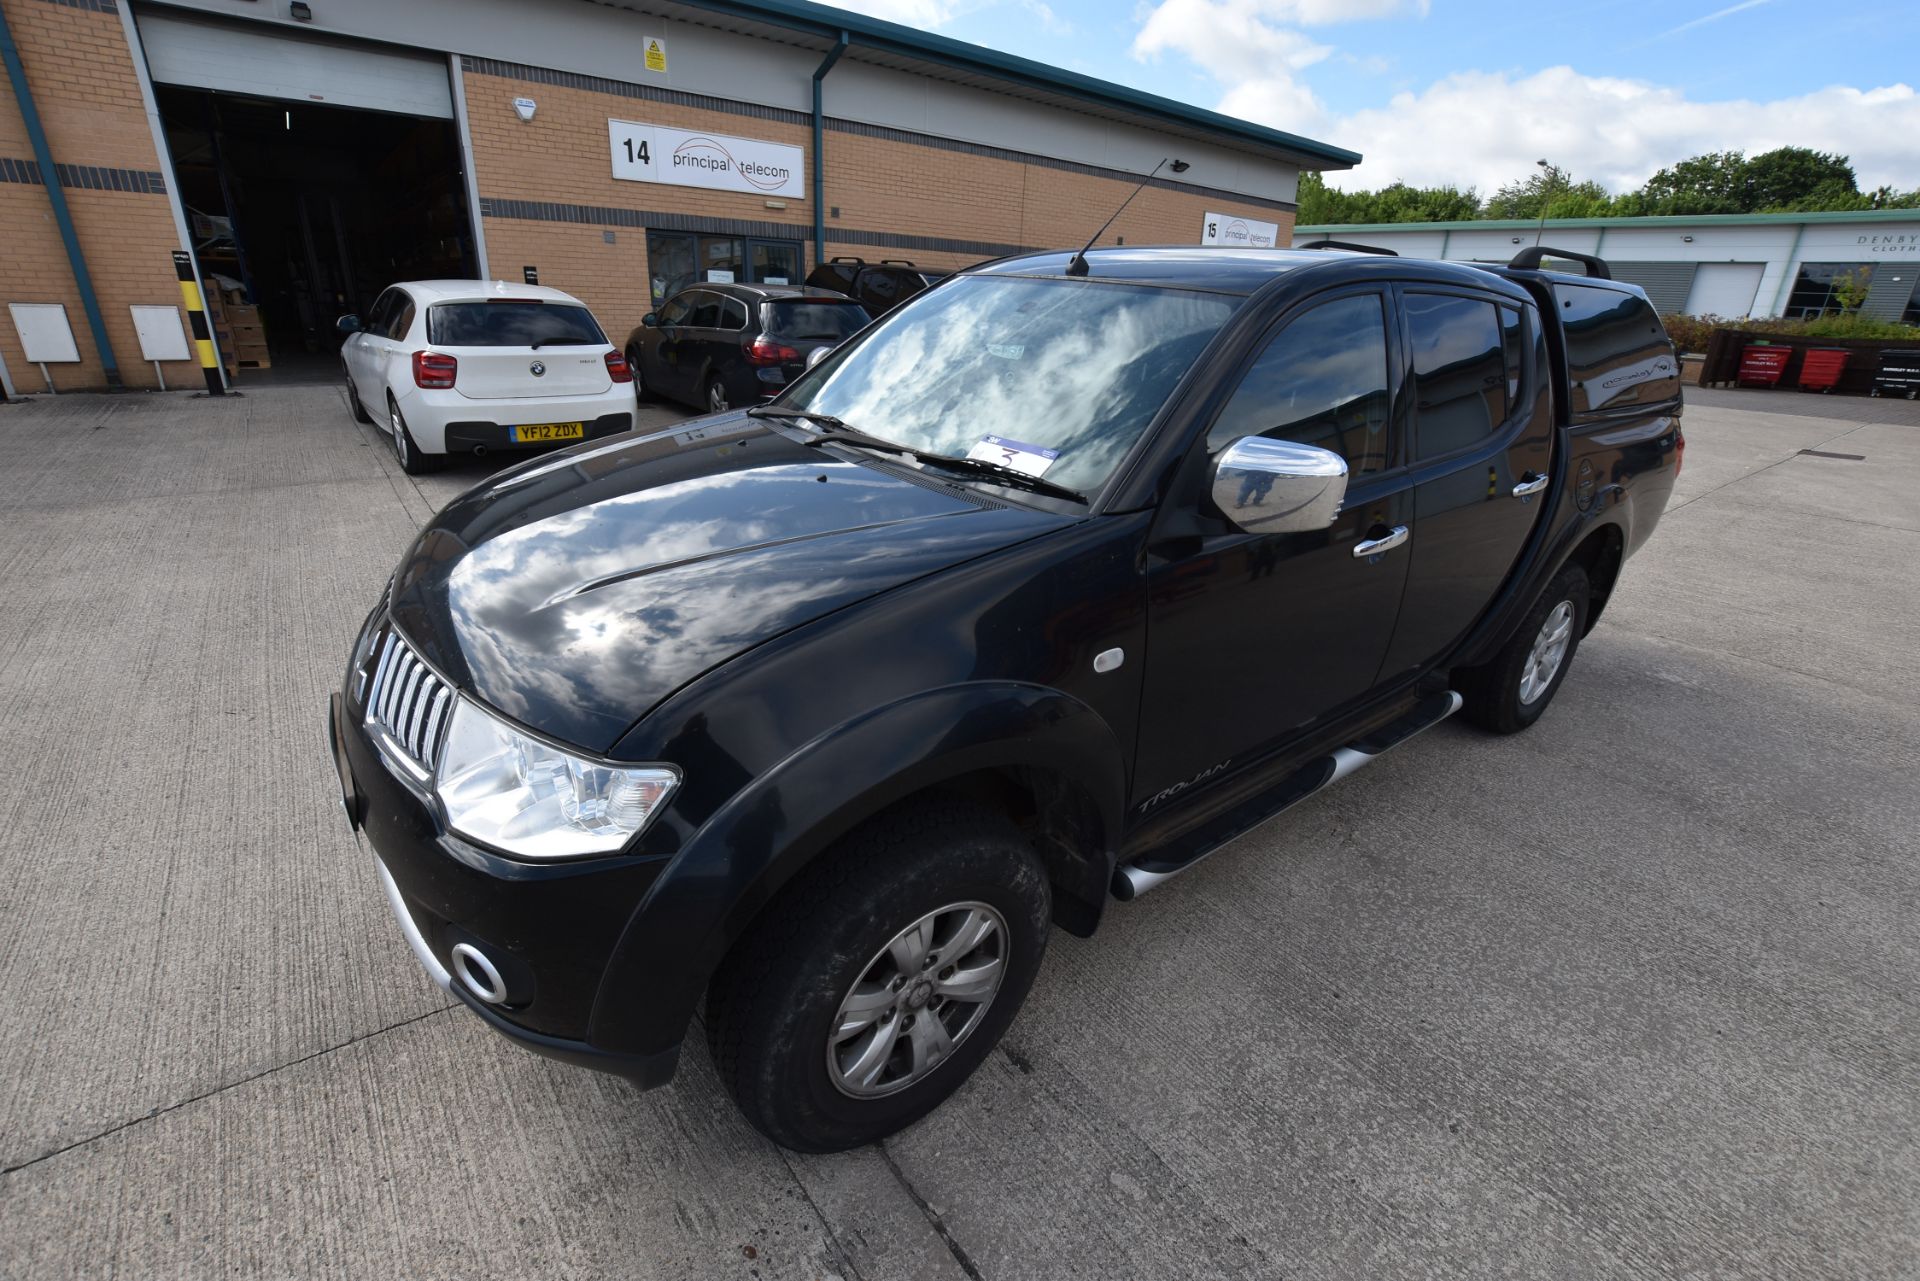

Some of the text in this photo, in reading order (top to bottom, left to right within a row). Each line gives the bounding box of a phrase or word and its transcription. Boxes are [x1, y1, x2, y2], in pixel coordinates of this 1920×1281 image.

[623, 138, 790, 179] 14 principal telecom
[1208, 222, 1217, 238] 15
[1857, 235, 1919, 244] DENBY
[521, 424, 578, 439] YF12 ZDX
[1139, 759, 1232, 813] TROJAN
